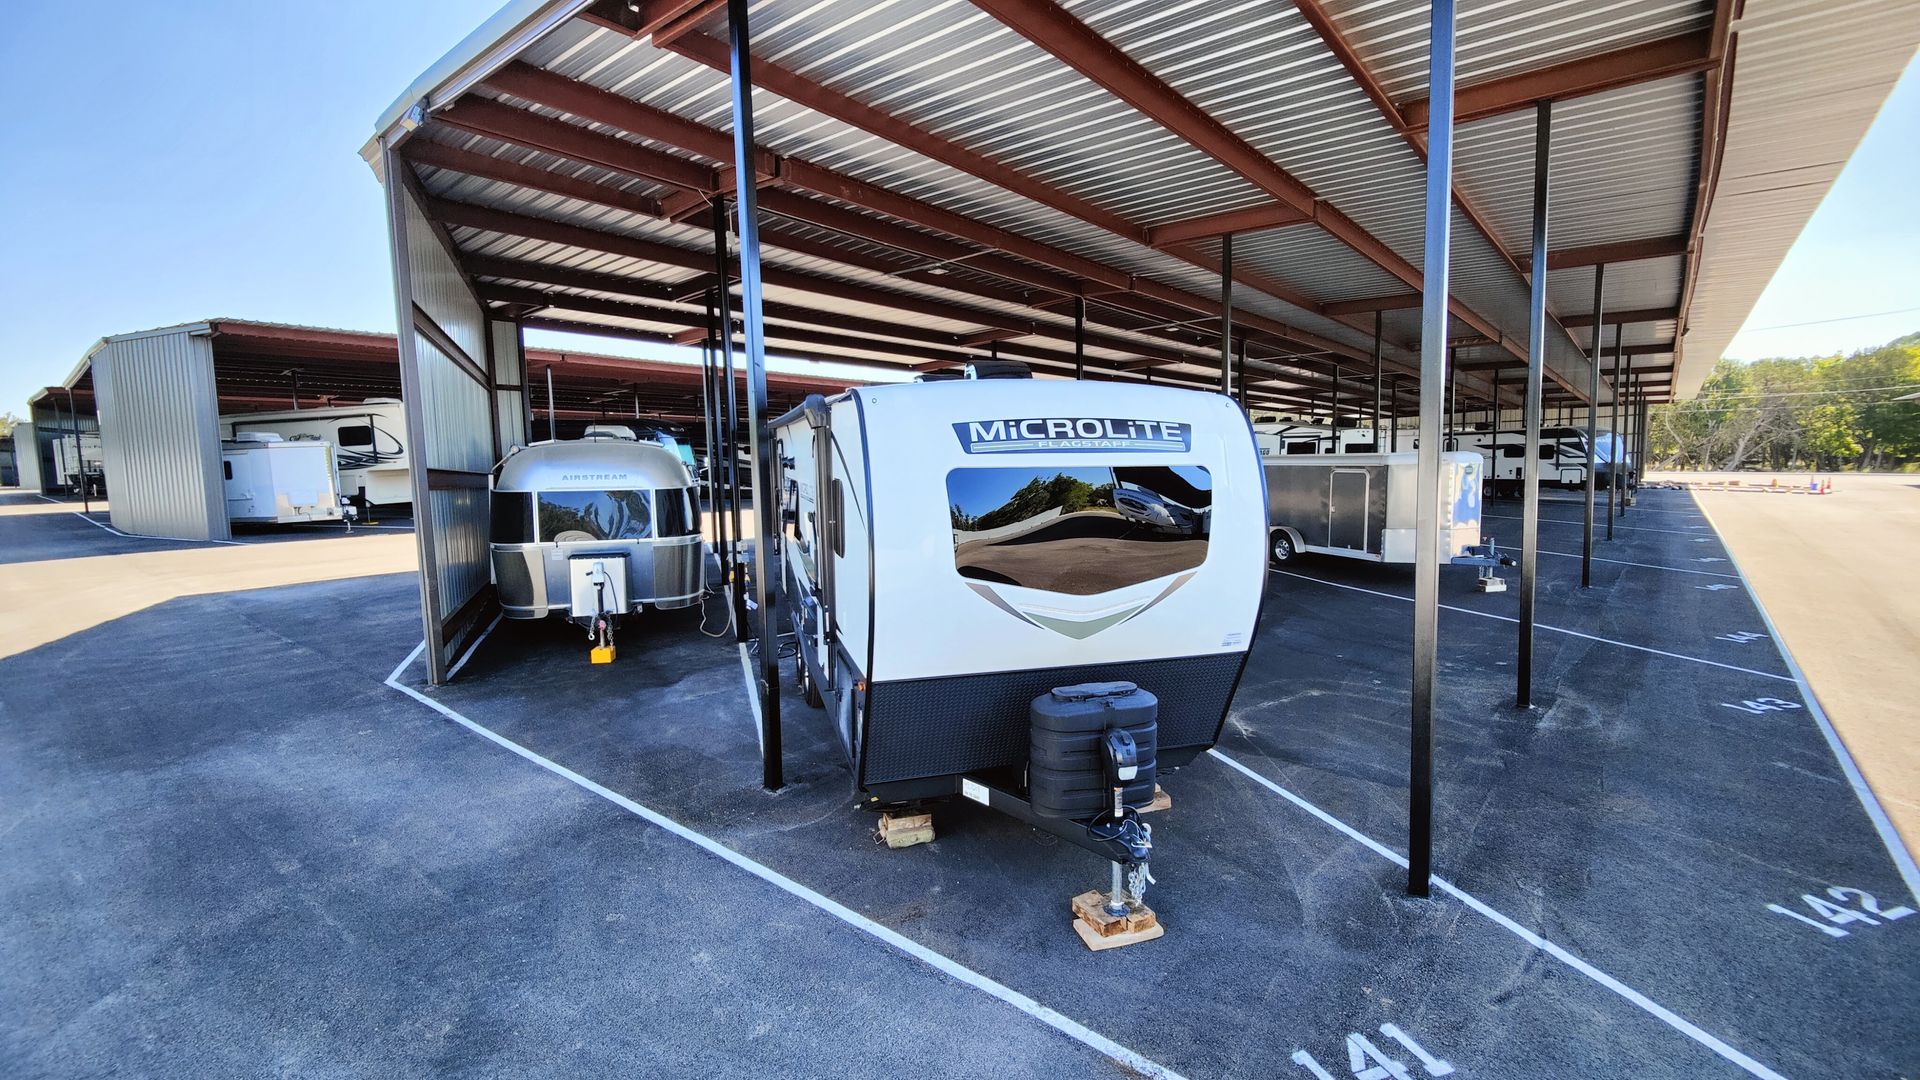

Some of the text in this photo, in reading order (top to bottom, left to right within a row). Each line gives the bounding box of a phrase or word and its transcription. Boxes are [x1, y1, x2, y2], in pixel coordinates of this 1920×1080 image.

[968, 419, 1183, 442] MiCROLiTE
[1037, 439, 1131, 448] FLAGSTAFF
[562, 473, 628, 481] AIRSTREAM
[1714, 631, 1769, 643] 144
[1721, 697, 1802, 714] 143
[1766, 886, 1918, 938] 142
